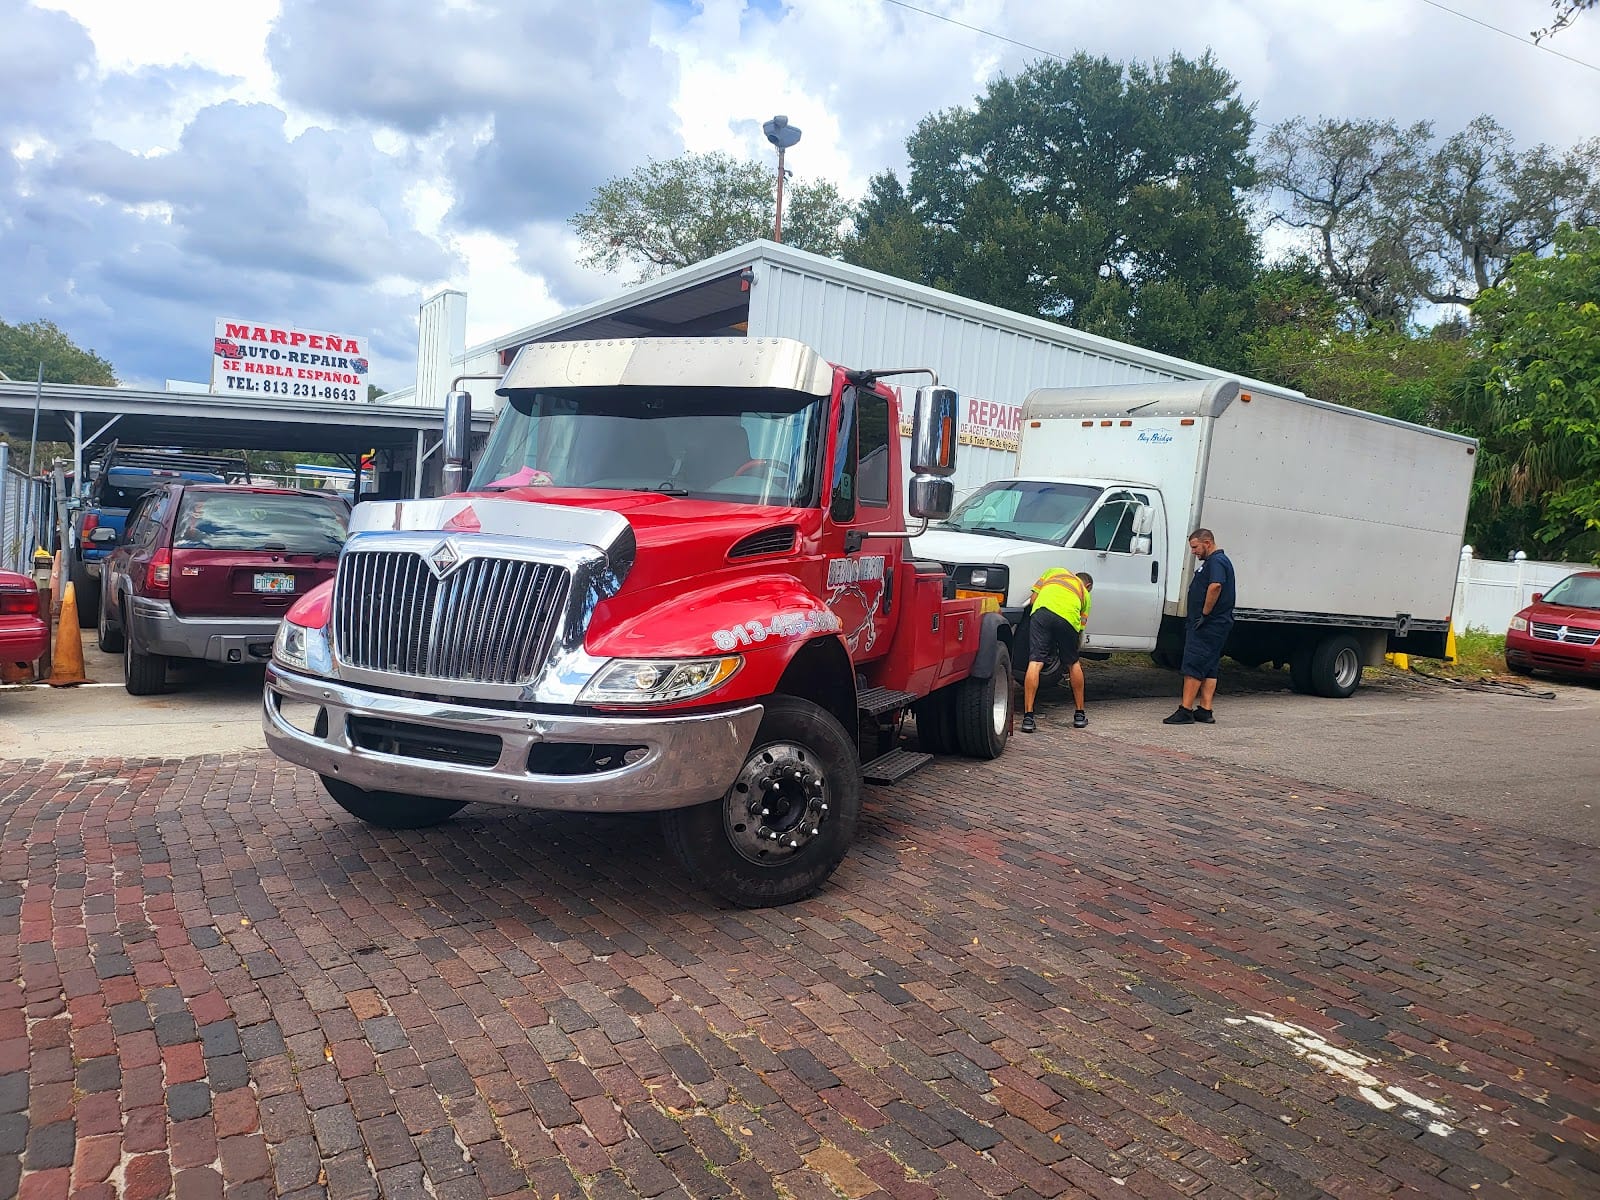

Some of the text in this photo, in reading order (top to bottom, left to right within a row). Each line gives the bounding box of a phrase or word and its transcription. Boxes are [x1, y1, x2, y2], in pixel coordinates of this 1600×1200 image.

[225, 323, 360, 354] MARPEÑA
[237, 345, 349, 369] AUTO-REPAIR
[223, 360, 361, 385] SE HABLA ESPAÑOL
[226, 375, 357, 401] TEL: 813 231-8643
[968, 399, 1023, 431] REPAIR
